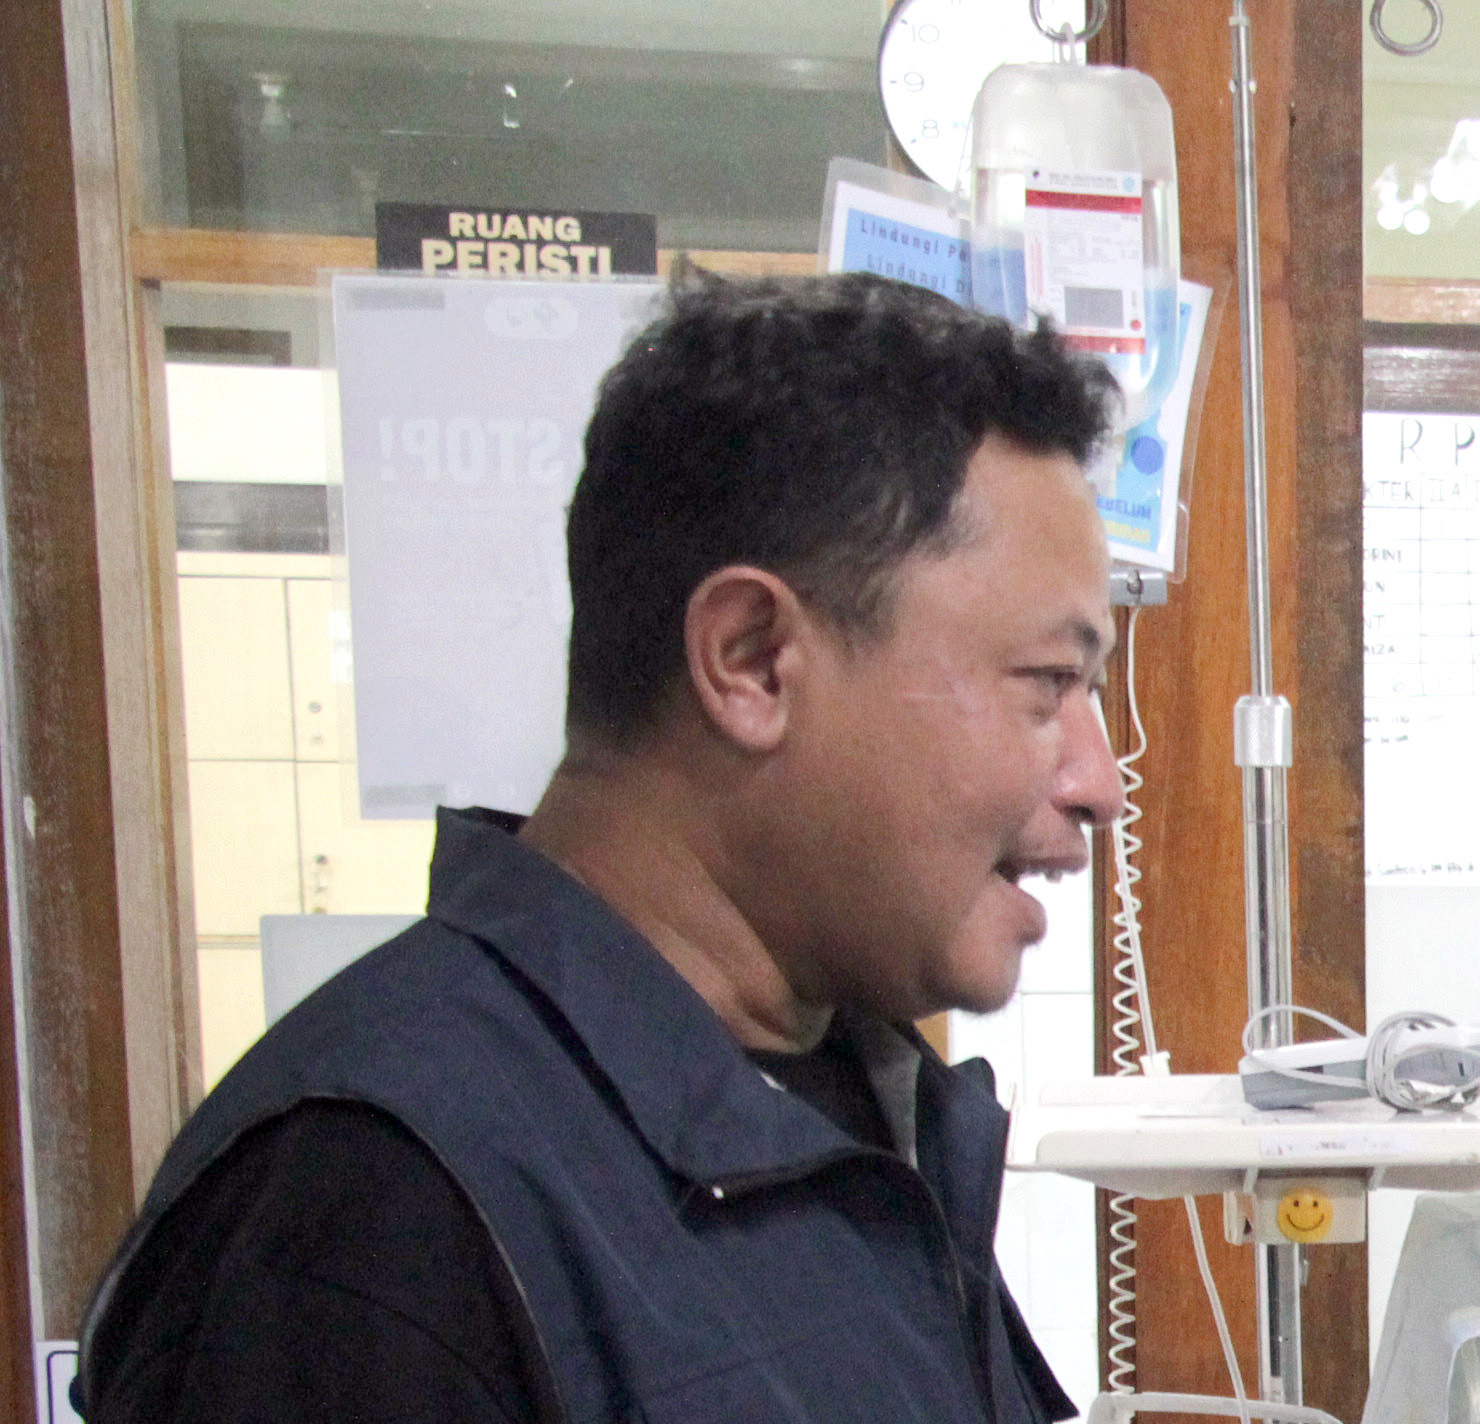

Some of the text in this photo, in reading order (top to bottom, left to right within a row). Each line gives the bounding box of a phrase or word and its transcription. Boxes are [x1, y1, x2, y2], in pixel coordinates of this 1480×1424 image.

[911, 24, 941, 43] 10
[904, 72, 925, 92] 9
[921, 119, 940, 138] 8
[448, 212, 582, 243] RUANG
[421, 240, 612, 276] PERISTI
[1400, 418, 1424, 465] R
